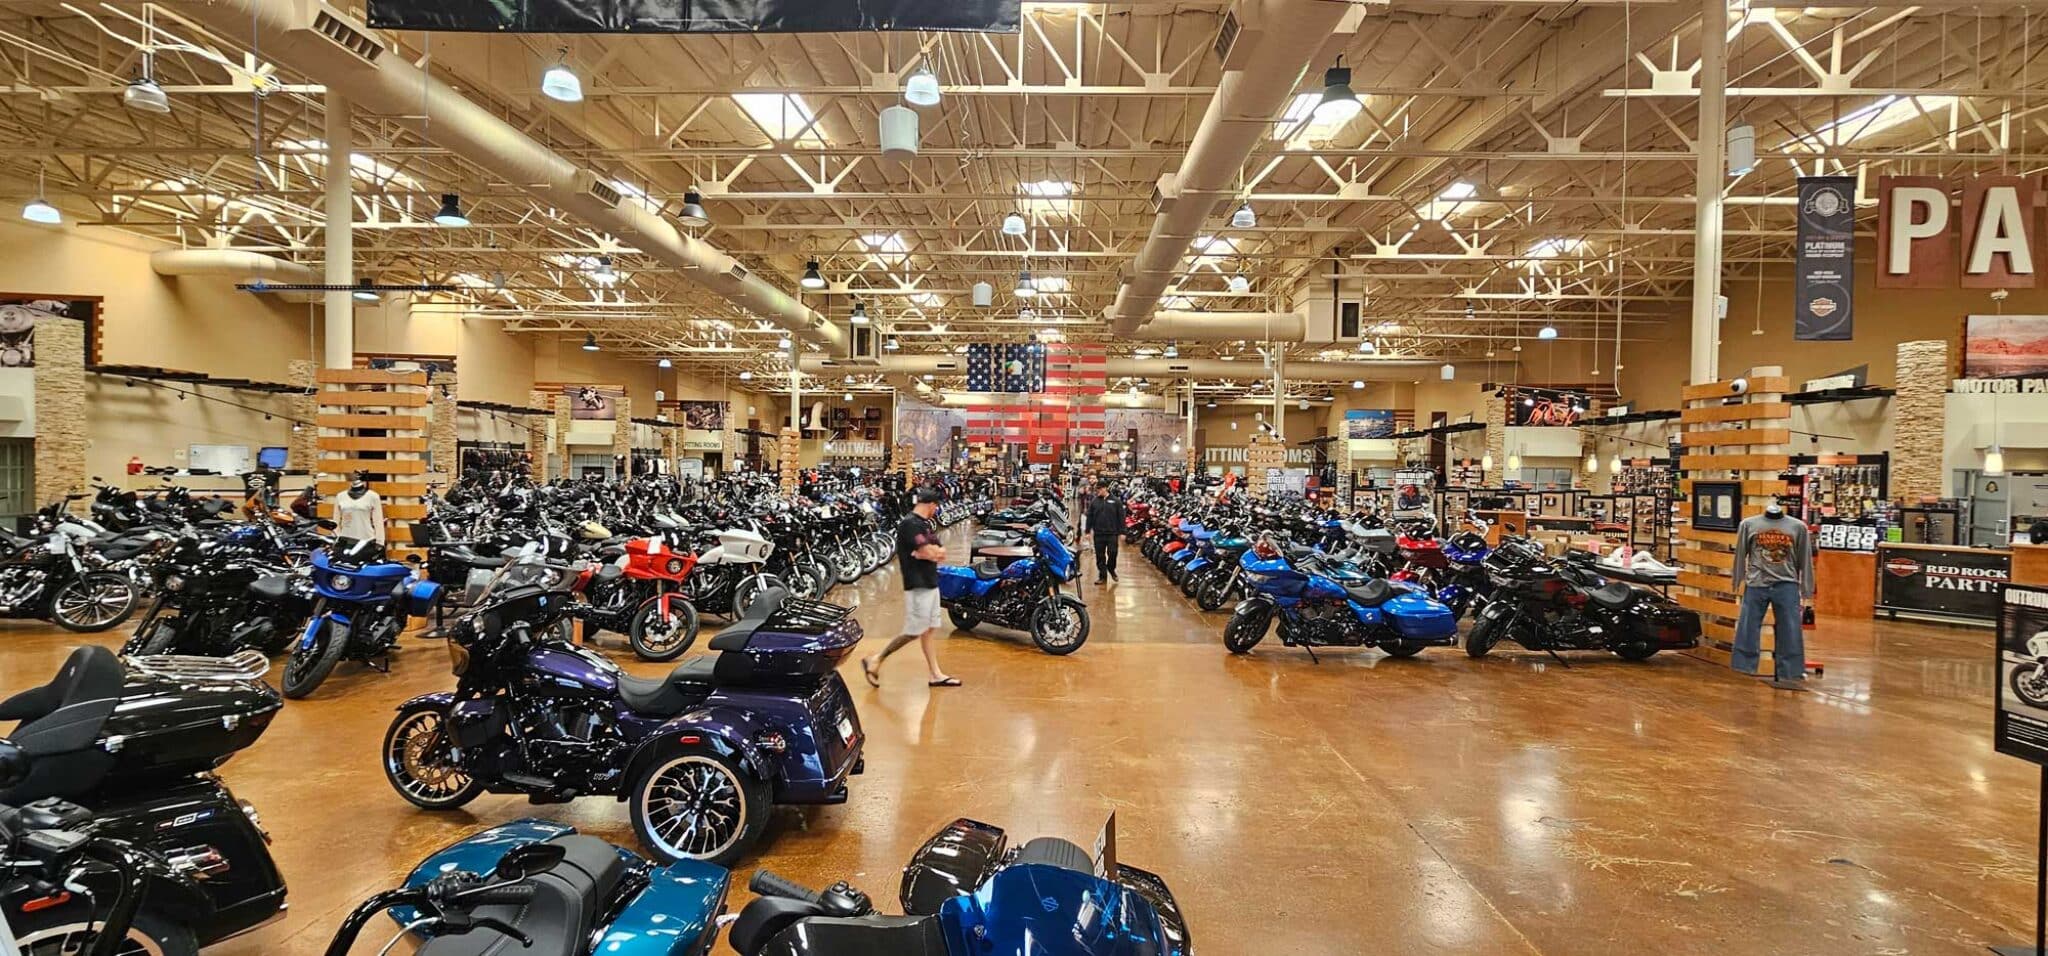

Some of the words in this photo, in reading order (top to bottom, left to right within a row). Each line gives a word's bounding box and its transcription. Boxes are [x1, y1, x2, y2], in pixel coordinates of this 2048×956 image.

[1805, 242, 1845, 250] PLATINUM
[1952, 378, 2018, 393] MOTOR
[1205, 447, 1250, 462] ITTING
[1925, 564, 1960, 575] RED
[1961, 566, 2008, 578] ROCK
